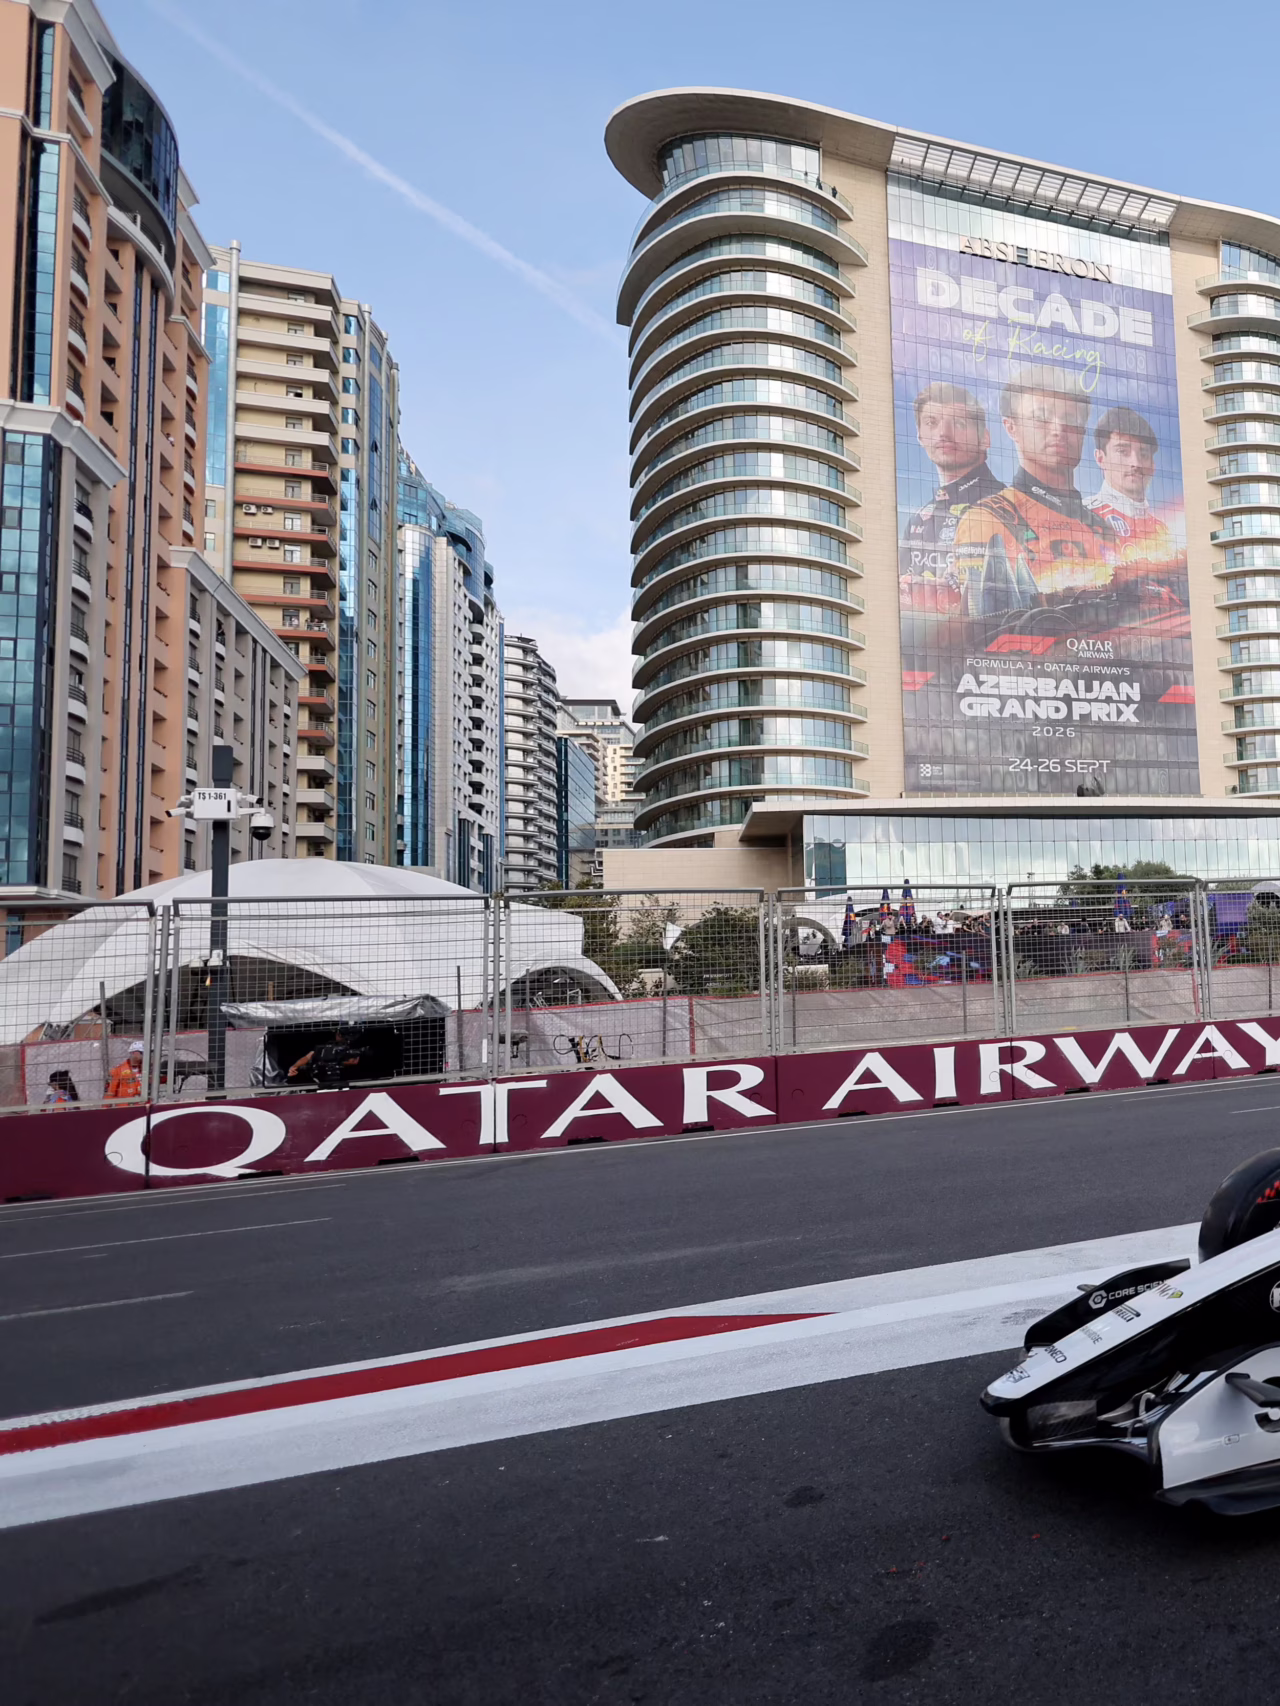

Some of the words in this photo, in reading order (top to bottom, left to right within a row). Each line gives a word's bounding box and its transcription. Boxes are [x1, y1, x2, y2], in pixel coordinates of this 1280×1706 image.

[959, 236, 1113, 283] ABSHERON
[916, 267, 1153, 347] DECADE
[963, 320, 992, 362] of
[1007, 317, 1108, 392] Racing
[1066, 638, 1113, 652] QATAR
[1078, 651, 1114, 660] AIRWAYS
[966, 658, 1024, 669] FORMULA
[1027, 661, 1033, 669] 1
[1044, 662, 1080, 673] QATAR
[1082, 665, 1130, 675] AIRWAYS
[956, 673, 1141, 701] AZERBAIJAN
[959, 696, 1068, 719] GRAND
[1072, 701, 1140, 723] PRIX
[1032, 726, 1075, 738] 2026
[1008, 758, 1061, 772] 24-26
[1064, 759, 1111, 773] SEPT
[198, 792, 206, 800] TS
[105, 1064, 776, 1179] QATAR
[1108, 1287, 1135, 1300] CORE
